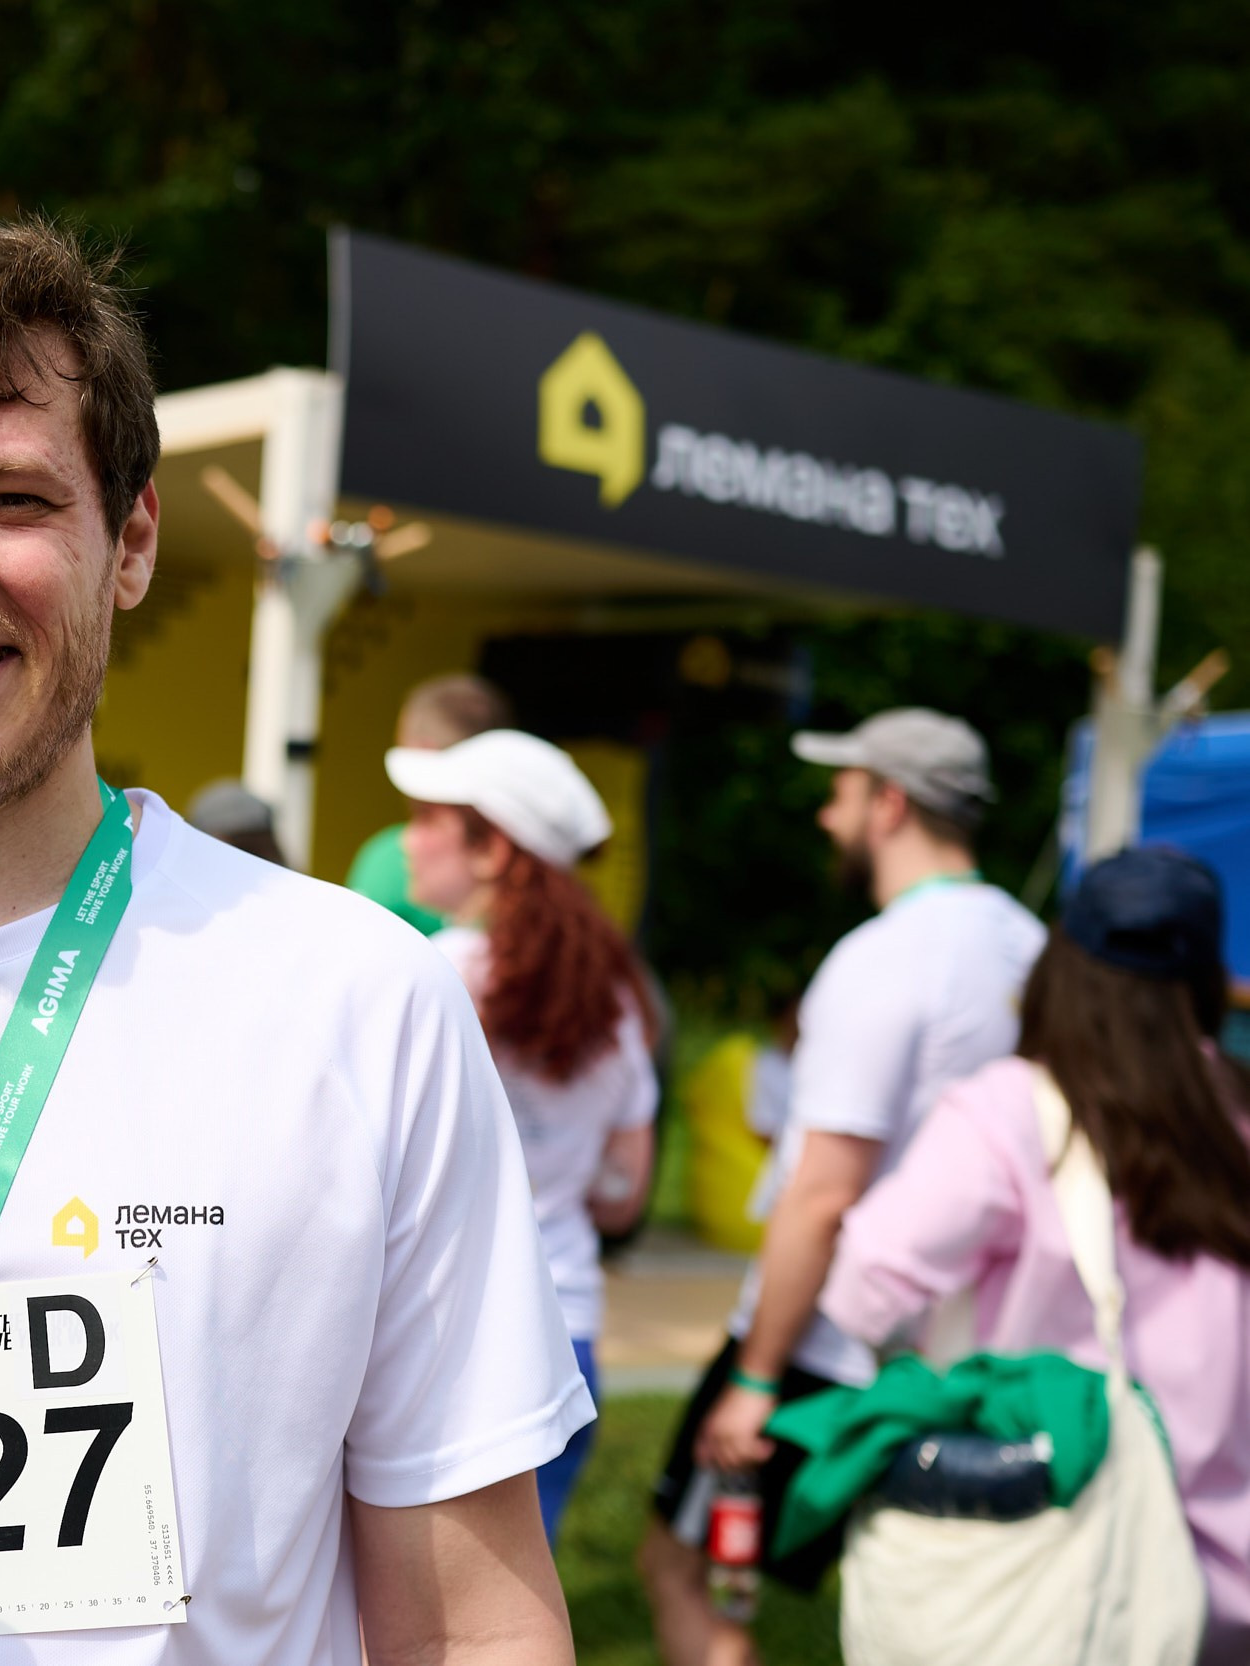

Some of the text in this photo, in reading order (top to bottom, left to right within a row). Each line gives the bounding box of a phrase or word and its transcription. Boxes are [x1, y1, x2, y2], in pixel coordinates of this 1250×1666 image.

[75, 860, 110, 922] LET THE SPORT
[85, 898, 104, 925] DRIVE
[97, 874, 115, 899] YOUR
[109, 848, 129, 874] WORK
[31, 950, 81, 1036] AGIMA
[2, 1097, 20, 1124] YOUR
[14, 1064, 34, 1095] WORK
[115, 1204, 224, 1225] лемана
[115, 1228, 162, 1249] тех
[27, 1294, 106, 1389] D
[16, 1604, 26, 1612] 15
[39, 1602, 50, 1611] 20
[63, 1600, 74, 1609] 25
[88, 1599, 98, 1607] 30
[112, 1597, 122, 1606] 35
[136, 1595, 146, 1604] 40
